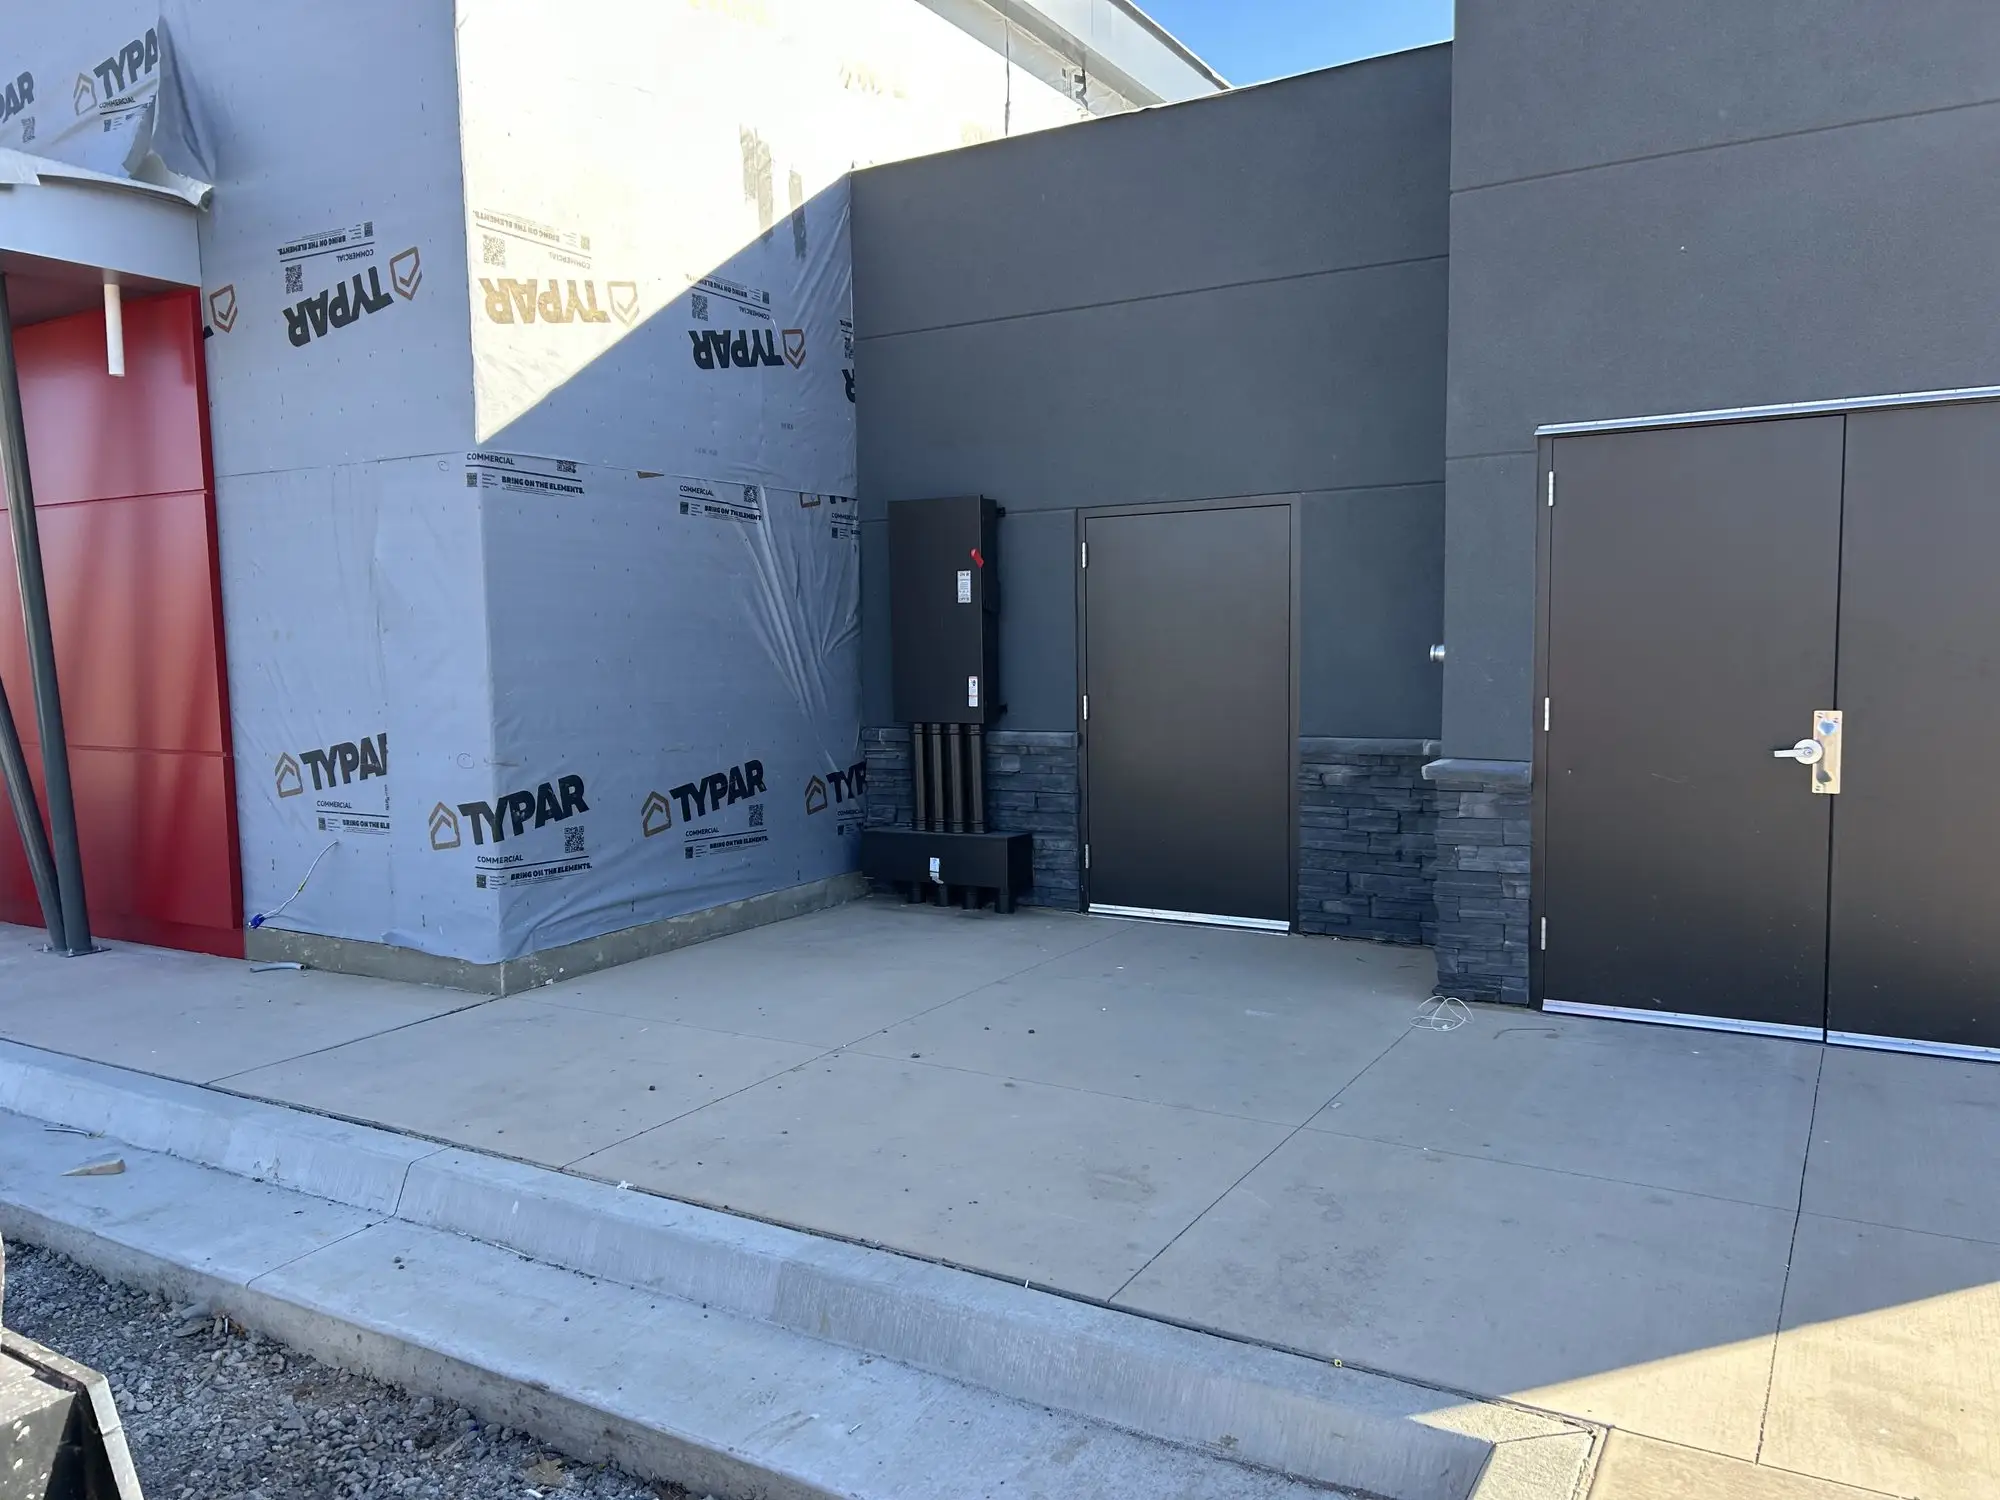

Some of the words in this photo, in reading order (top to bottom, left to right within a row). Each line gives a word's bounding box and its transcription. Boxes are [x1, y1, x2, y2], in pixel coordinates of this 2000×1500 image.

[336, 249, 374, 262] COMMERCIAL
[282, 266, 394, 347] TYPAR
[478, 278, 612, 324] TYPAR
[738, 306, 770, 321] COMMERCIAL
[688, 329, 785, 370] TYPAR
[466, 453, 515, 466] COMMERCIAL
[501, 475, 524, 486] BRING
[524, 478, 535, 487] ON
[535, 480, 549, 489] THE
[679, 485, 714, 497] COMMERCIAL
[668, 759, 768, 822] TYPAR
[316, 800, 352, 809] COMMERCIAL
[457, 774, 590, 846] TYPAR
[685, 827, 719, 837] COMMERCIAL
[477, 854, 524, 864] COMMERCIAL
[510, 870, 532, 881] BRING
[533, 869, 544, 877] ON
[544, 867, 557, 876] THE
